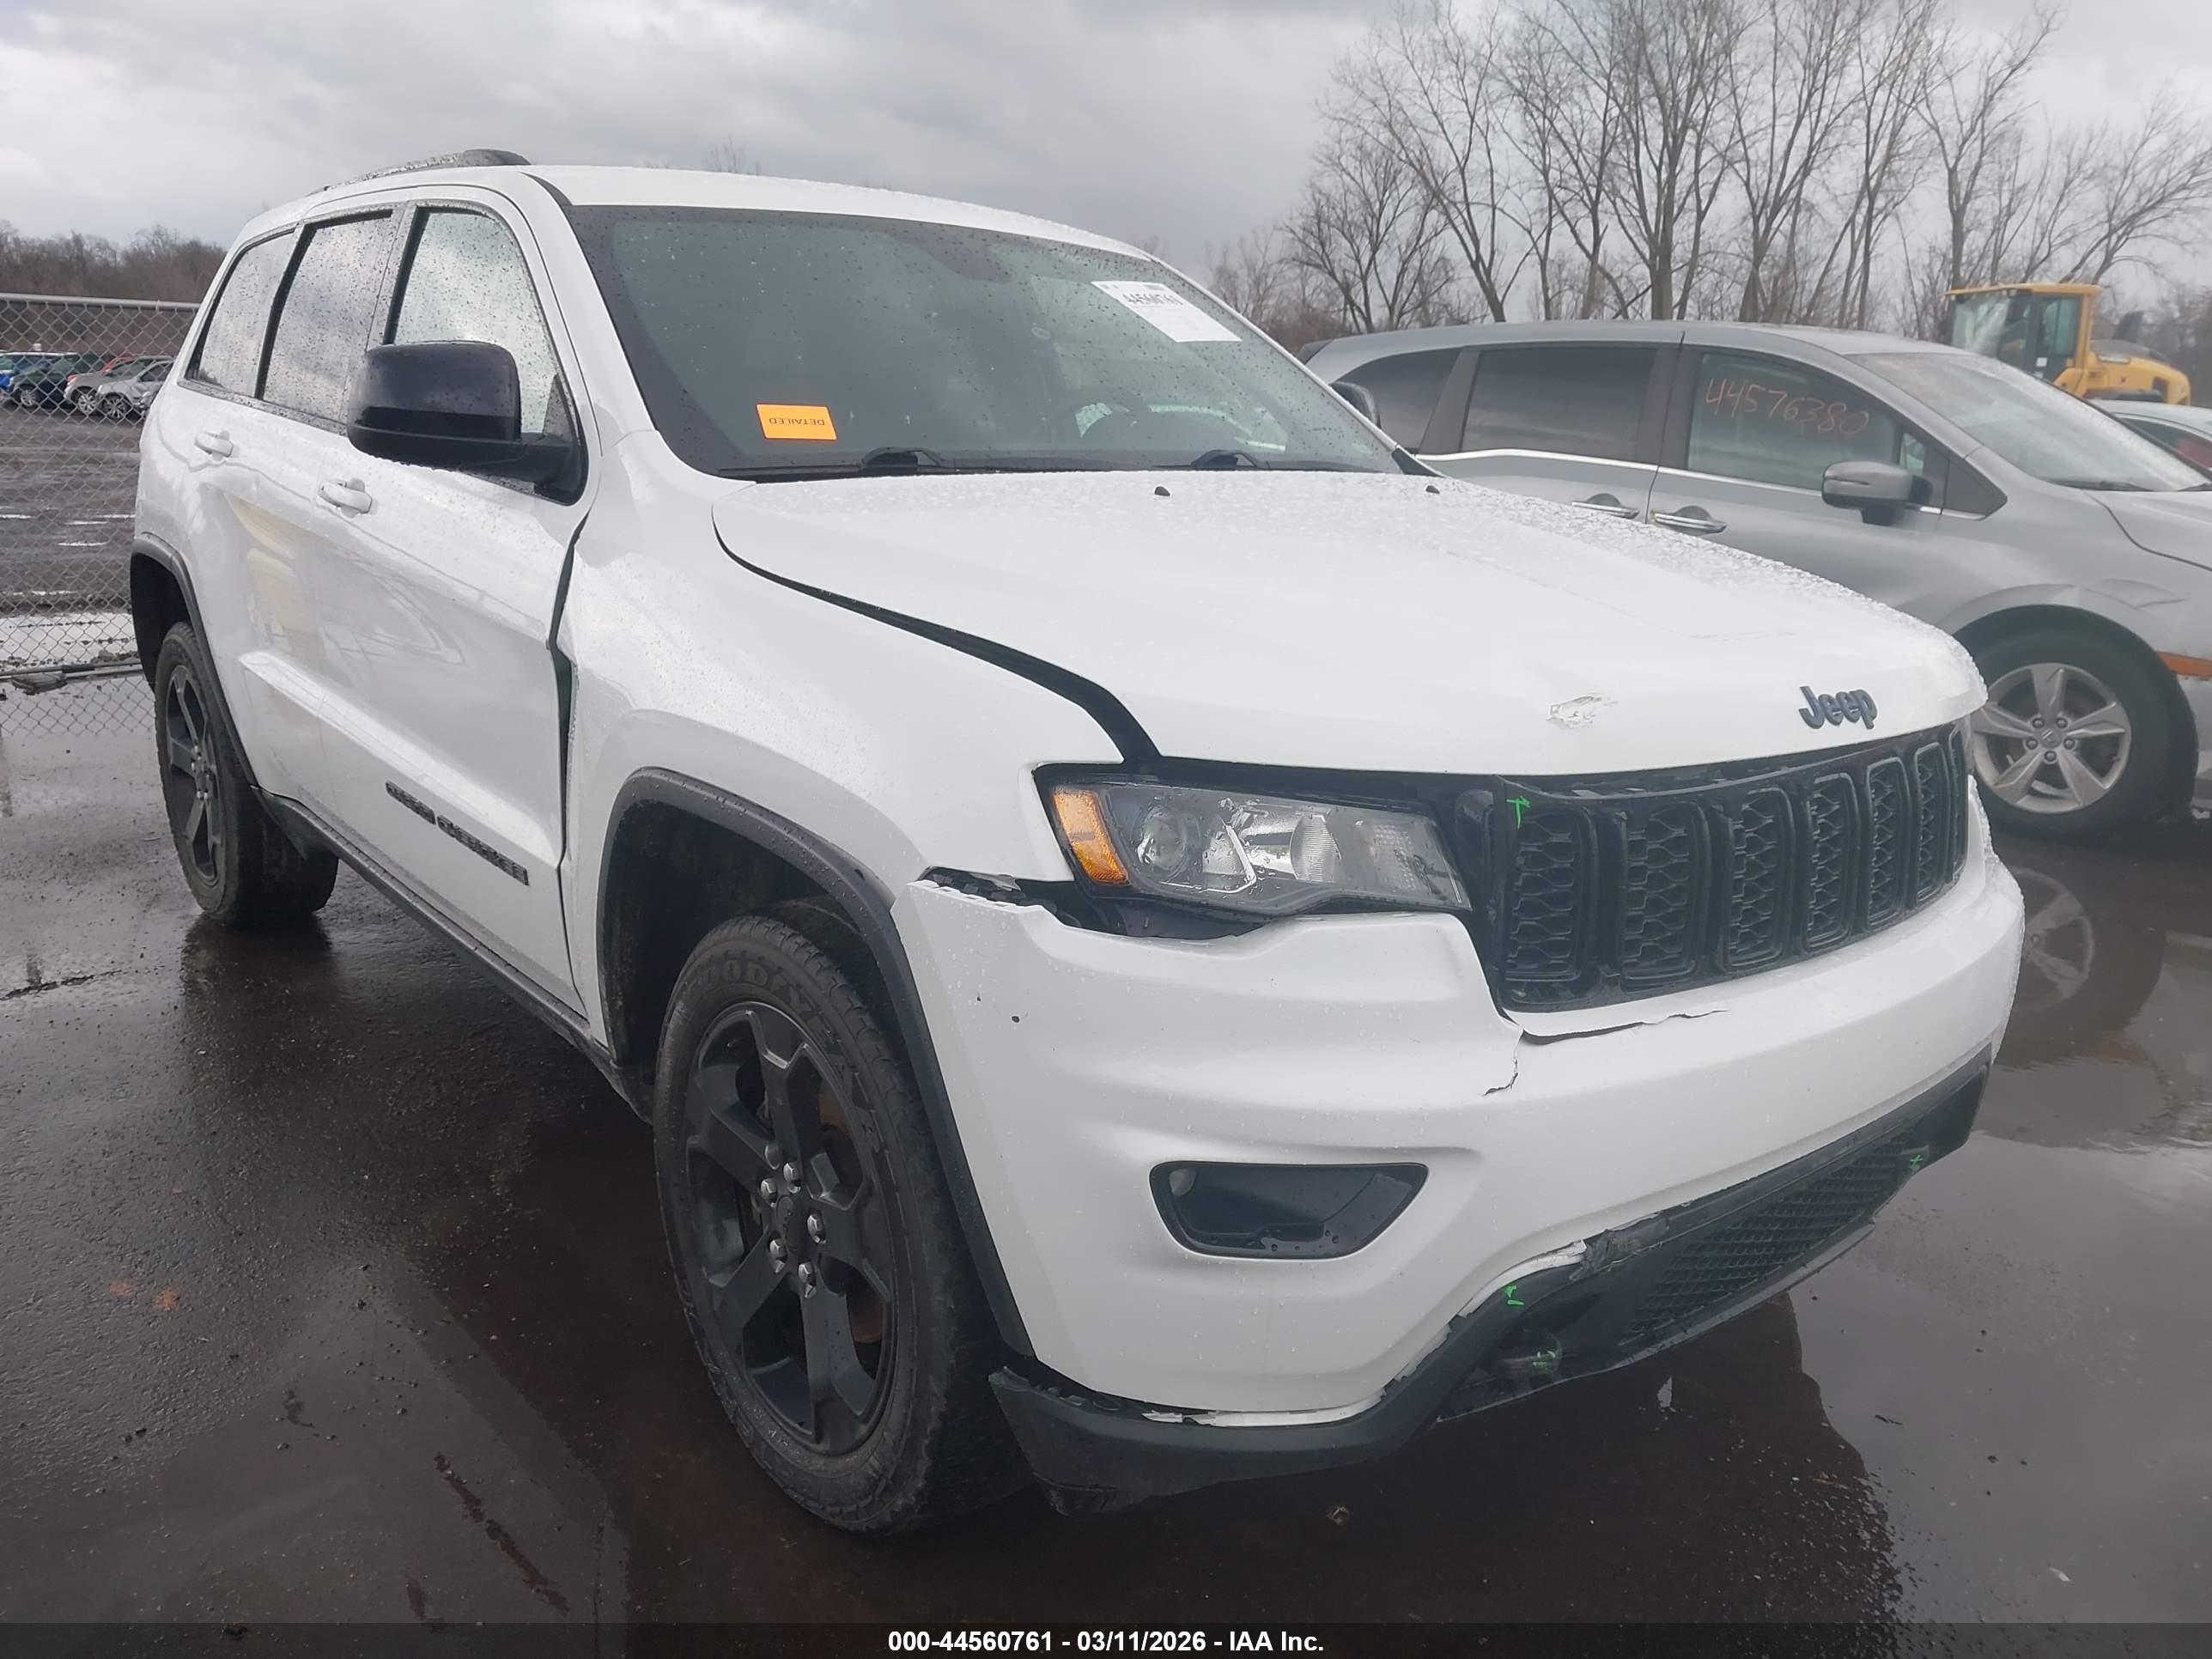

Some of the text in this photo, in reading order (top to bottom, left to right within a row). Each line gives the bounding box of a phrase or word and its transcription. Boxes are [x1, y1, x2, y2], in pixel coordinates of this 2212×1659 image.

[769, 417, 826, 426] DETAILED
[1705, 377, 1869, 434] 44576380
[1798, 685, 1878, 730] Jeep
